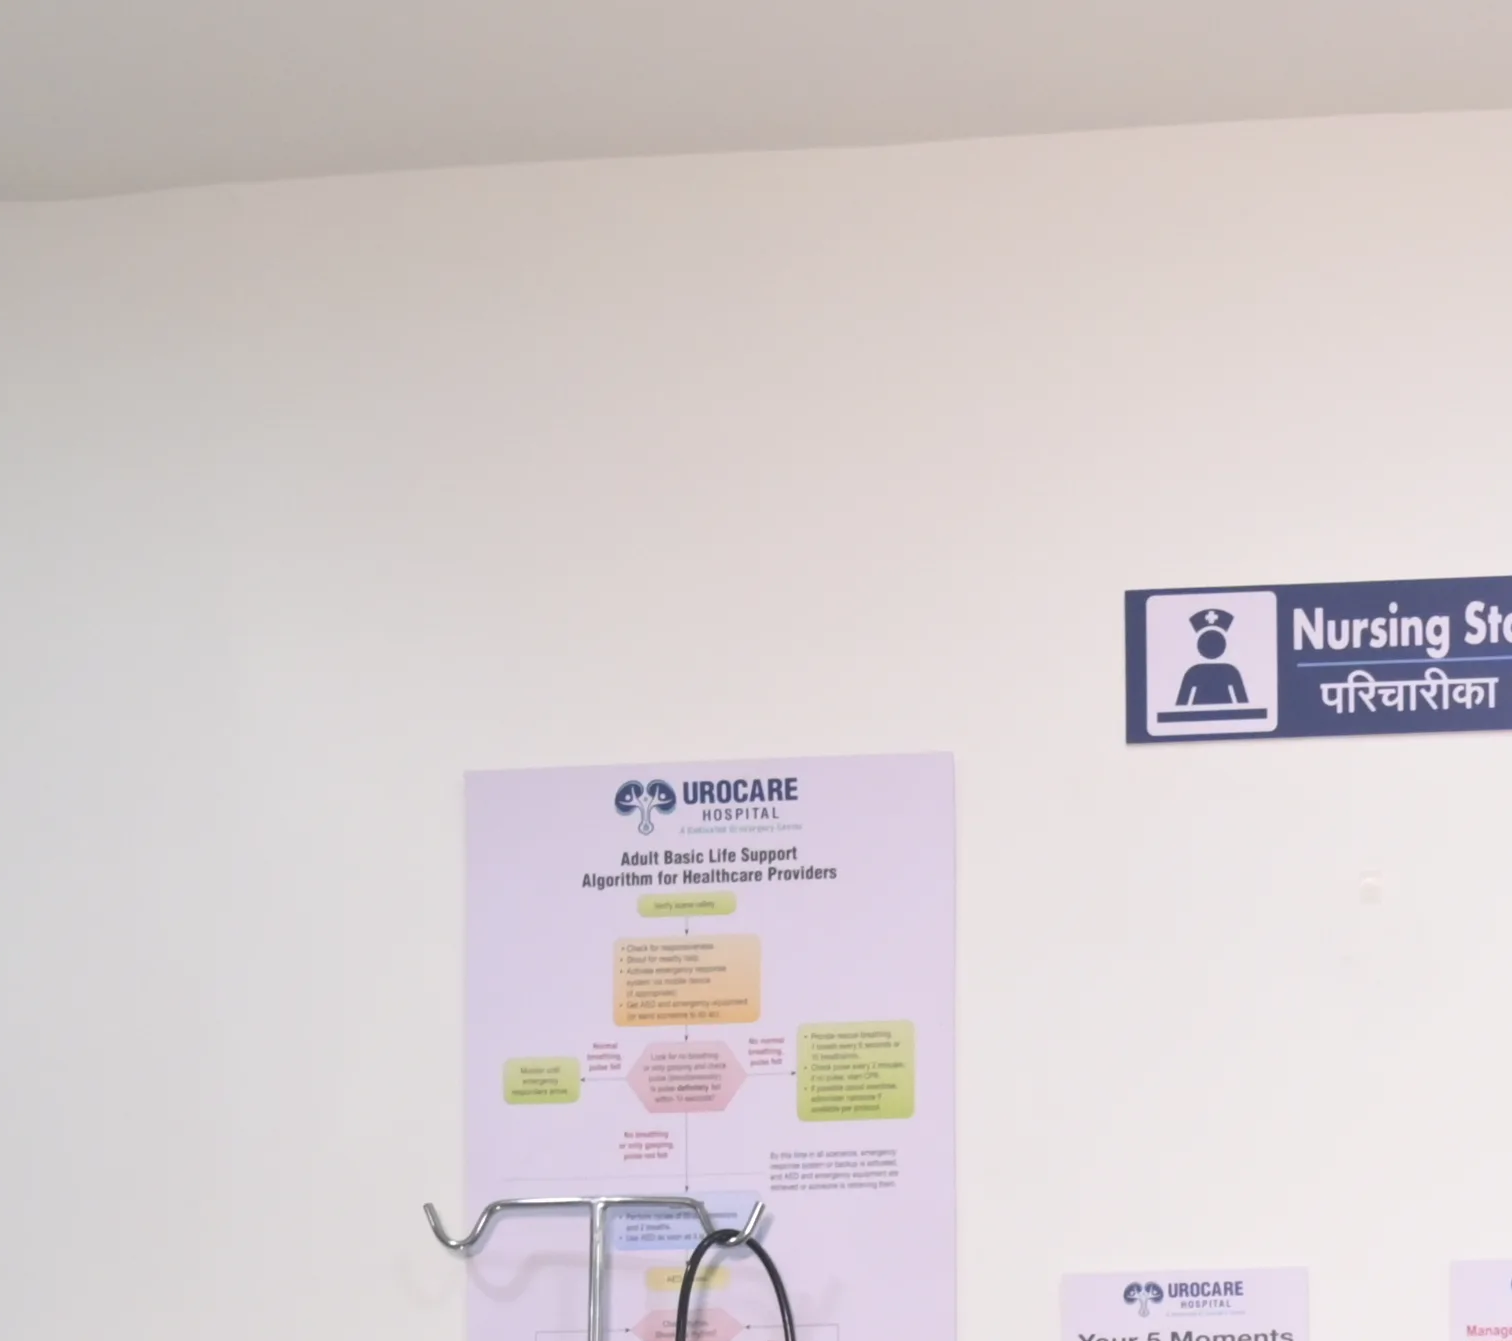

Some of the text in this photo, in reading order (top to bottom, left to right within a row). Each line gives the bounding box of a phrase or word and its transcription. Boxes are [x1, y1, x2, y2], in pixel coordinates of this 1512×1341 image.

[1293, 603, 1450, 659] Nursing
[1320, 668, 1498, 714] परिचारीका
[683, 778, 798, 805] UROCARE
[702, 807, 779, 822] HOSPITAL
[621, 846, 797, 867] Adult Basic Life Support
[582, 865, 837, 890] Algorithm for Healthcare Providers
[1168, 1281, 1244, 1298] UROCARE
[1180, 1299, 1231, 1308] HOSPITAL
